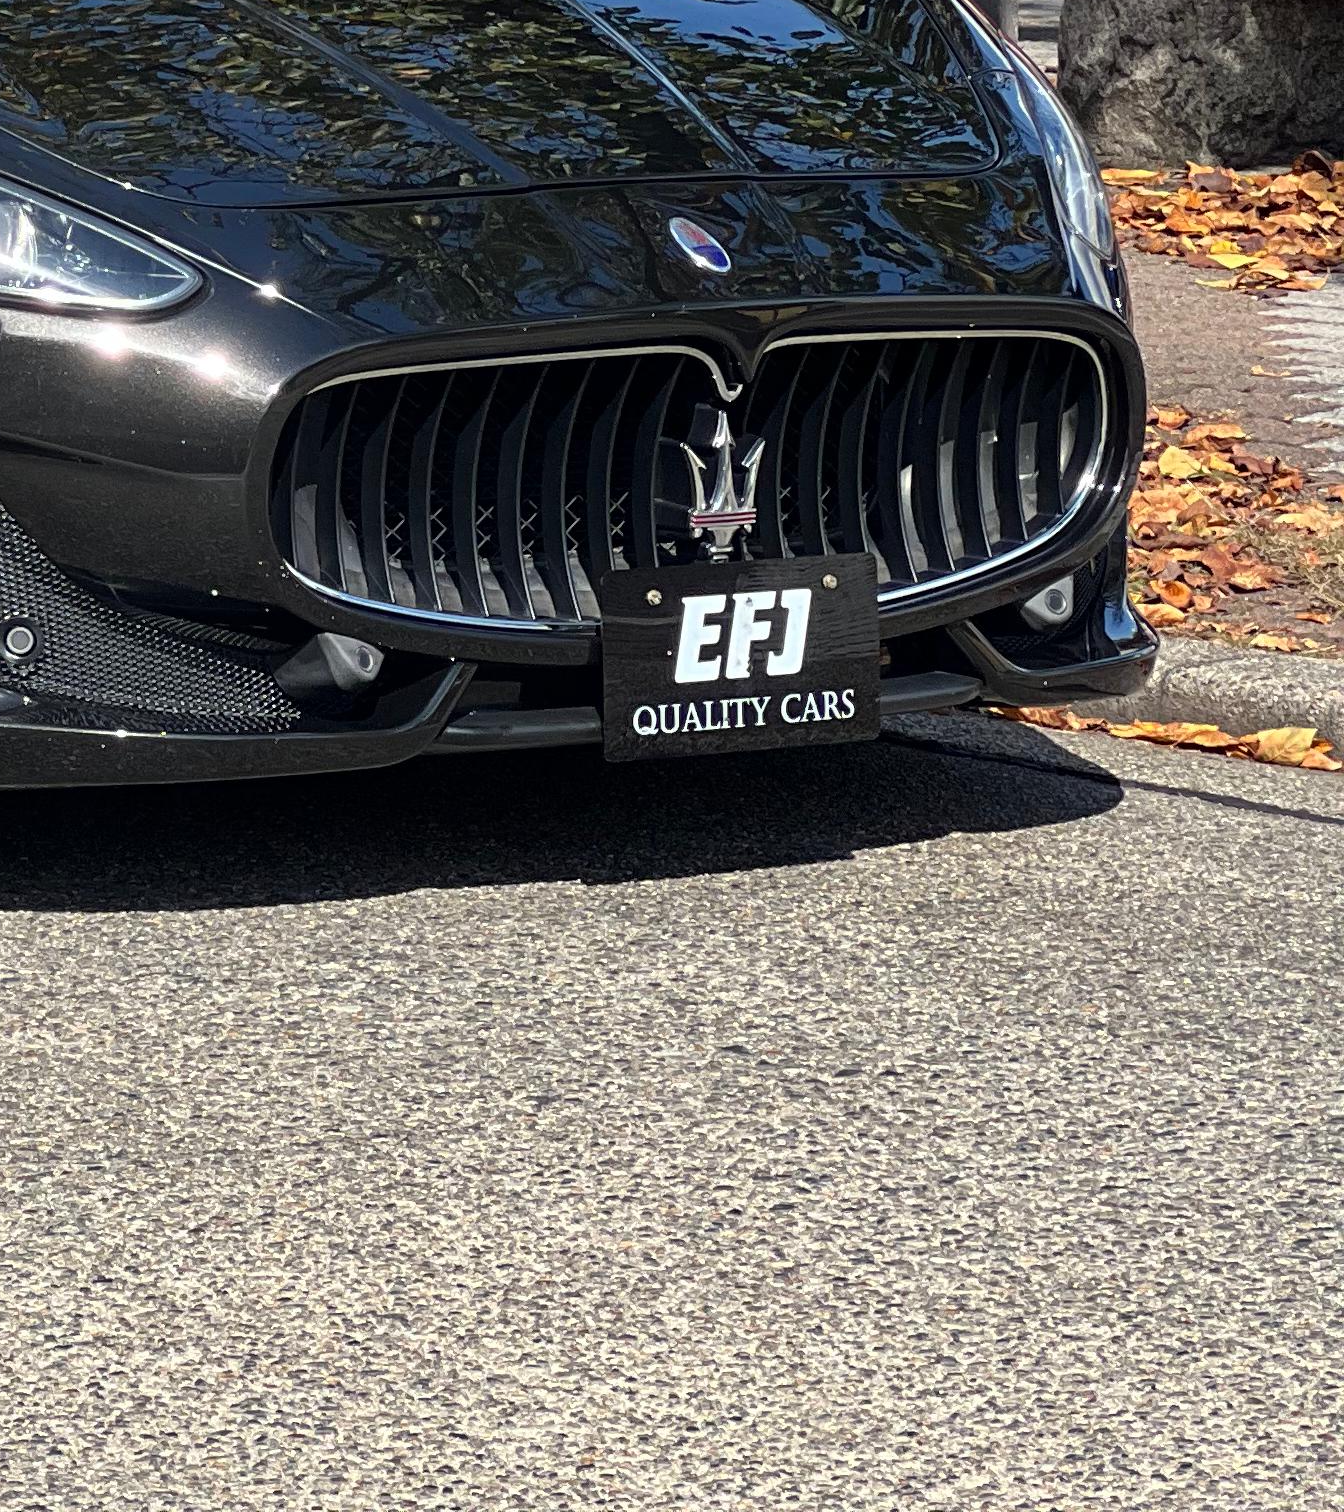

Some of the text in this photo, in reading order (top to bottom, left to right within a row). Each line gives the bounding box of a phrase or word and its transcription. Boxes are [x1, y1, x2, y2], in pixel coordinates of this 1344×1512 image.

[674, 588, 812, 684] EFJ
[632, 688, 856, 736] QUALITY CARS
